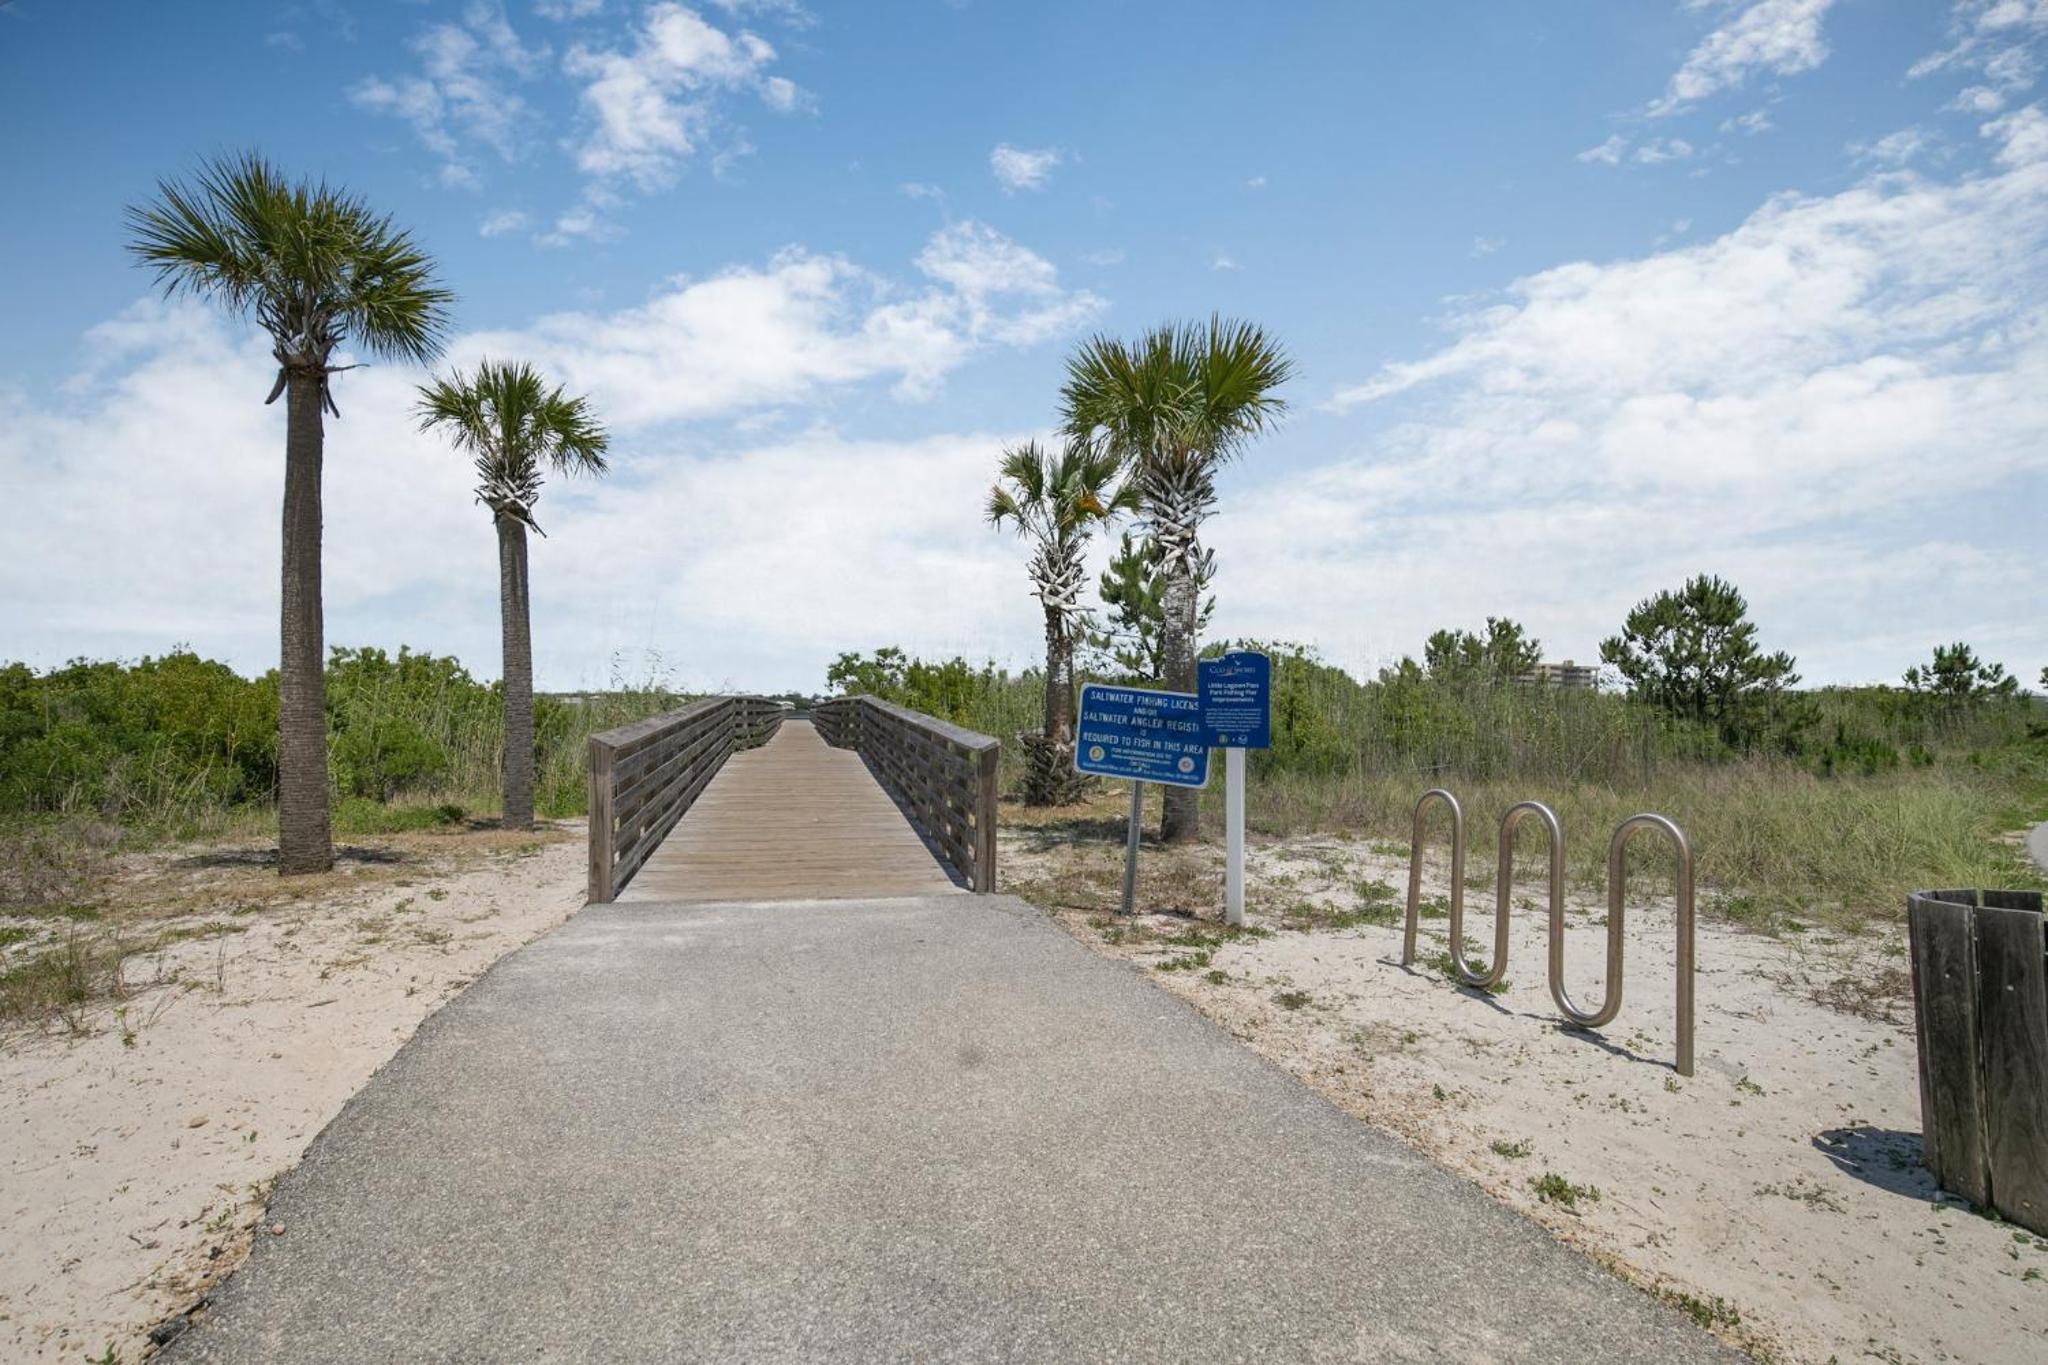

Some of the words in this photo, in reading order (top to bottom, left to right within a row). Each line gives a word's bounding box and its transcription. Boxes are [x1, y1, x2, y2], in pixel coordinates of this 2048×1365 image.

[1223, 682, 1245, 690] Lagoon
[1223, 689, 1244, 697] Fishing
[1090, 690, 1134, 704] SALTWATER
[1137, 695, 1168, 708] FISHING
[1171, 699, 1199, 711] LICENS
[1083, 711, 1128, 725] SALTWATER
[1130, 716, 1164, 729] ANGLER
[1083, 732, 1119, 745] REQUIRED
[1121, 736, 1131, 746] TO
[1134, 737, 1151, 748] FISH
[1153, 740, 1161, 749] IN
[1164, 740, 1181, 752] THIS
[1183, 743, 1204, 754] AREA
